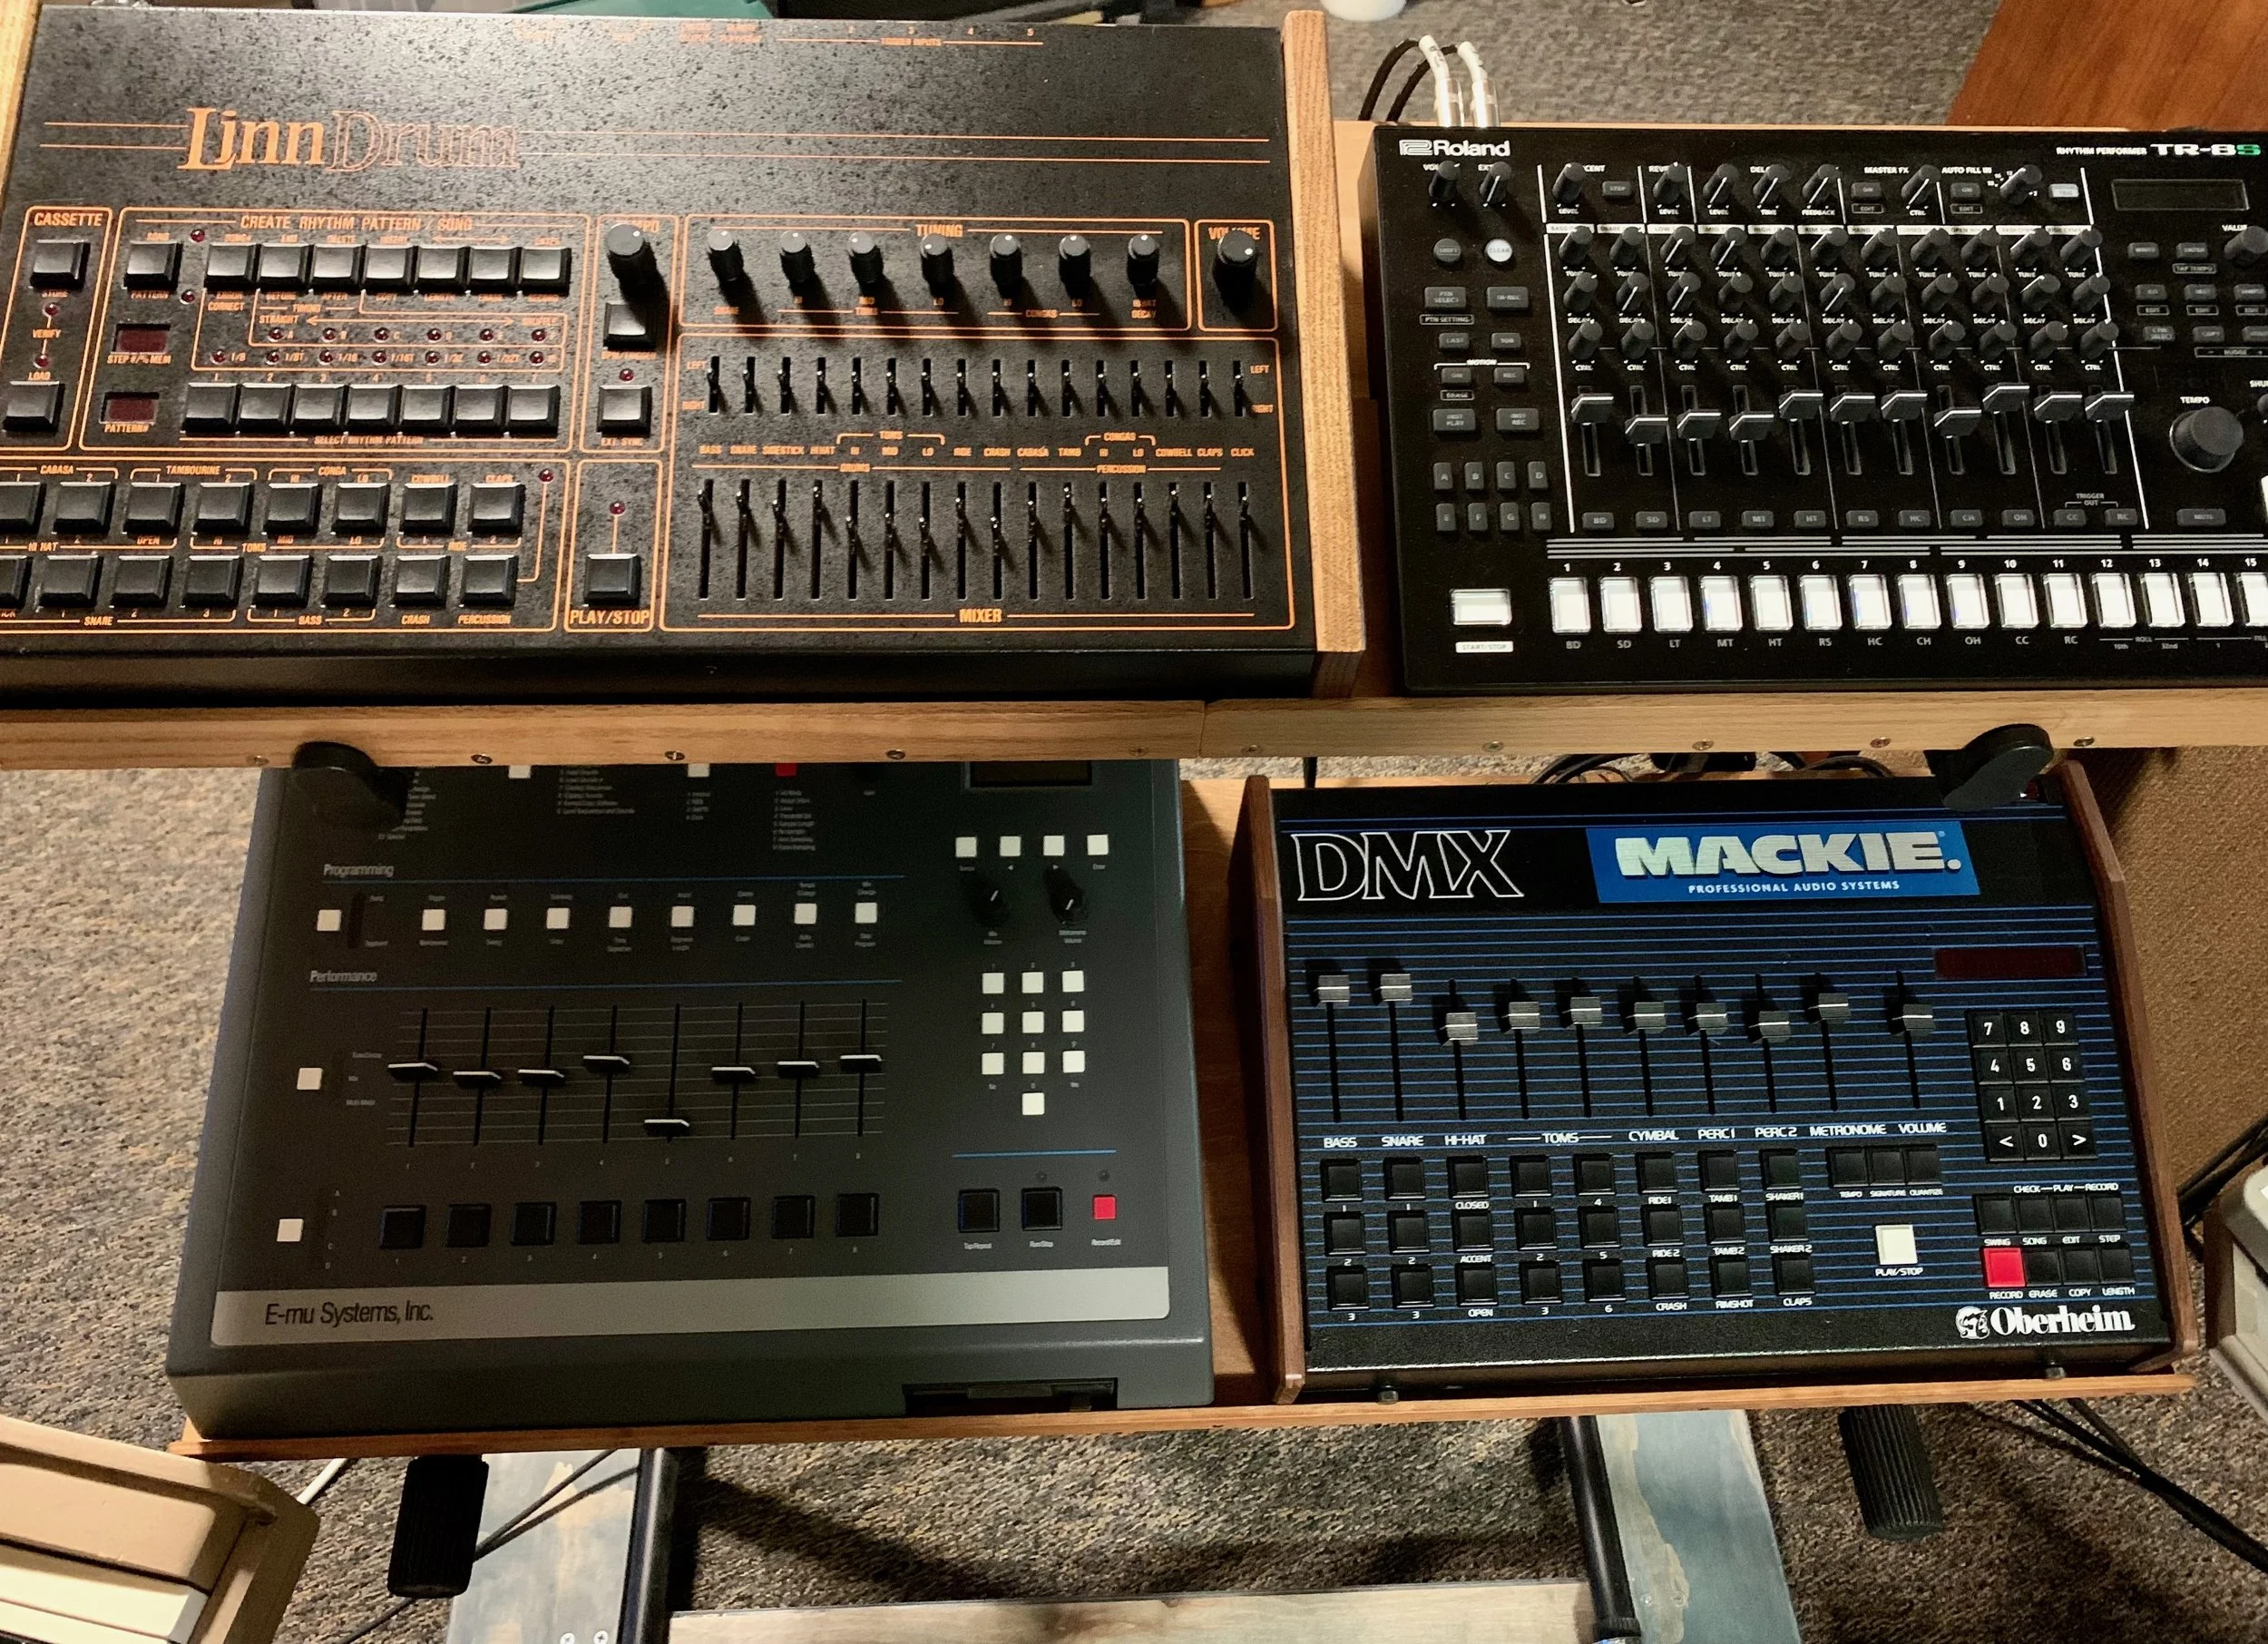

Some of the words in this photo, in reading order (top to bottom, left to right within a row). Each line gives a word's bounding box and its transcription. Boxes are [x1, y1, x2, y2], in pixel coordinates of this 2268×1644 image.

[1434, 140, 1510, 156] Roland
[2097, 147, 2146, 155] PERFORMER
[2151, 144, 2261, 155] TR-8S
[34, 212, 103, 226] CASSETTE
[240, 216, 290, 228] CREATE
[299, 217, 355, 229] RHYTHM
[363, 218, 421, 230] PATTERN
[438, 219, 473, 231] SONG
[915, 224, 963, 238] TUNING
[33, 329, 60, 338] VERIFY
[166, 465, 220, 475] TAMBOURINE
[241, 543, 266, 553] TOMS
[1613, 563, 1621, 571] 2
[1663, 562, 1671, 571] 3
[1713, 562, 1721, 570] 4
[1763, 561, 1770, 570] 5
[1813, 561, 1820, 569] 6
[1861, 560, 1868, 569] 7
[1910, 560, 1917, 569] 8
[1959, 560, 1966, 569] 9
[2004, 560, 2017, 569] 10
[2053, 560, 2064, 568] 11
[2101, 559, 2113, 568] 12
[2149, 559, 2161, 567] 13
[2197, 558, 2209, 567] 14
[2245, 558, 2256, 567] 15
[1564, 563, 1570, 572] 1
[401, 615, 430, 625] CRASH
[457, 615, 511, 624] PERCUSSION
[570, 610, 650, 625] PLAY/STOP
[959, 608, 1002, 623] MIXER
[84, 617, 113, 626] SNARE
[1669, 640, 1680, 648] LT
[1717, 639, 1733, 647] MT
[1769, 638, 1783, 647] HT
[1819, 638, 1832, 646] RS
[1868, 637, 1882, 646] HC
[1917, 637, 1931, 645] CH
[1965, 637, 1981, 645] OH
[2065, 636, 2077, 644] RC
[1566, 641, 1581, 649] BD
[1618, 641, 1631, 649] SD
[1290, 829, 1524, 901] DMX
[324, 864, 394, 878] Programming
[1688, 884, 1787, 894] PROFESSIONAL
[1794, 882, 1836, 892] AUDIO
[1842, 880, 1900, 890] SYSTEMS
[310, 971, 377, 983] Performance
[1984, 1023, 1992, 1035] 7
[2020, 1022, 2029, 1034] 8
[2056, 1021, 2066, 1033] 9
[1990, 1059, 1999, 1072] 4
[2026, 1058, 2035, 1072] 5
[2062, 1058, 2071, 1071] 6
[1998, 1098, 2004, 1111] 1
[2032, 1096, 2042, 1110] 2
[2068, 1095, 2078, 1109] 3
[1810, 1124, 1887, 1137] METRONOME
[1898, 1122, 1947, 1134] VOLUME
[1445, 1135, 1487, 1145] HI-HAT
[1542, 1132, 1579, 1143] TOMS
[1629, 1130, 1678, 1141] CYMBAL
[1324, 1137, 1357, 1148] BASS
[1382, 1136, 1423, 1147] SNARE
[2038, 1134, 2048, 1148] 0
[2053, 1184, 2074, 1192] PLAY
[2085, 1183, 2118, 1191] RECORD
[1455, 1201, 1490, 1209] CLOSED
[1344, 1258, 1352, 1267] 2
[1460, 1255, 1492, 1263] ACCENT
[1989, 1291, 2023, 1299] RECORD
[2028, 1289, 2058, 1297] ERASE
[2068, 1289, 2091, 1297] COPY
[2103, 1287, 2135, 1296] LENGTH
[1716, 1299, 1754, 1308] RIMSHOT
[1784, 1297, 1812, 1306] CLAPS
[1656, 1302, 1686, 1311] CRASH
[265, 1304, 314, 1325] E-mu
[320, 1302, 400, 1327] Systems,
[406, 1300, 434, 1322] Inc.
[1348, 1313, 1355, 1321] 3
[1413, 1311, 1420, 1319] 3
[1468, 1308, 1493, 1317] OPEN
[1990, 1305, 2136, 1336] Oberheim
